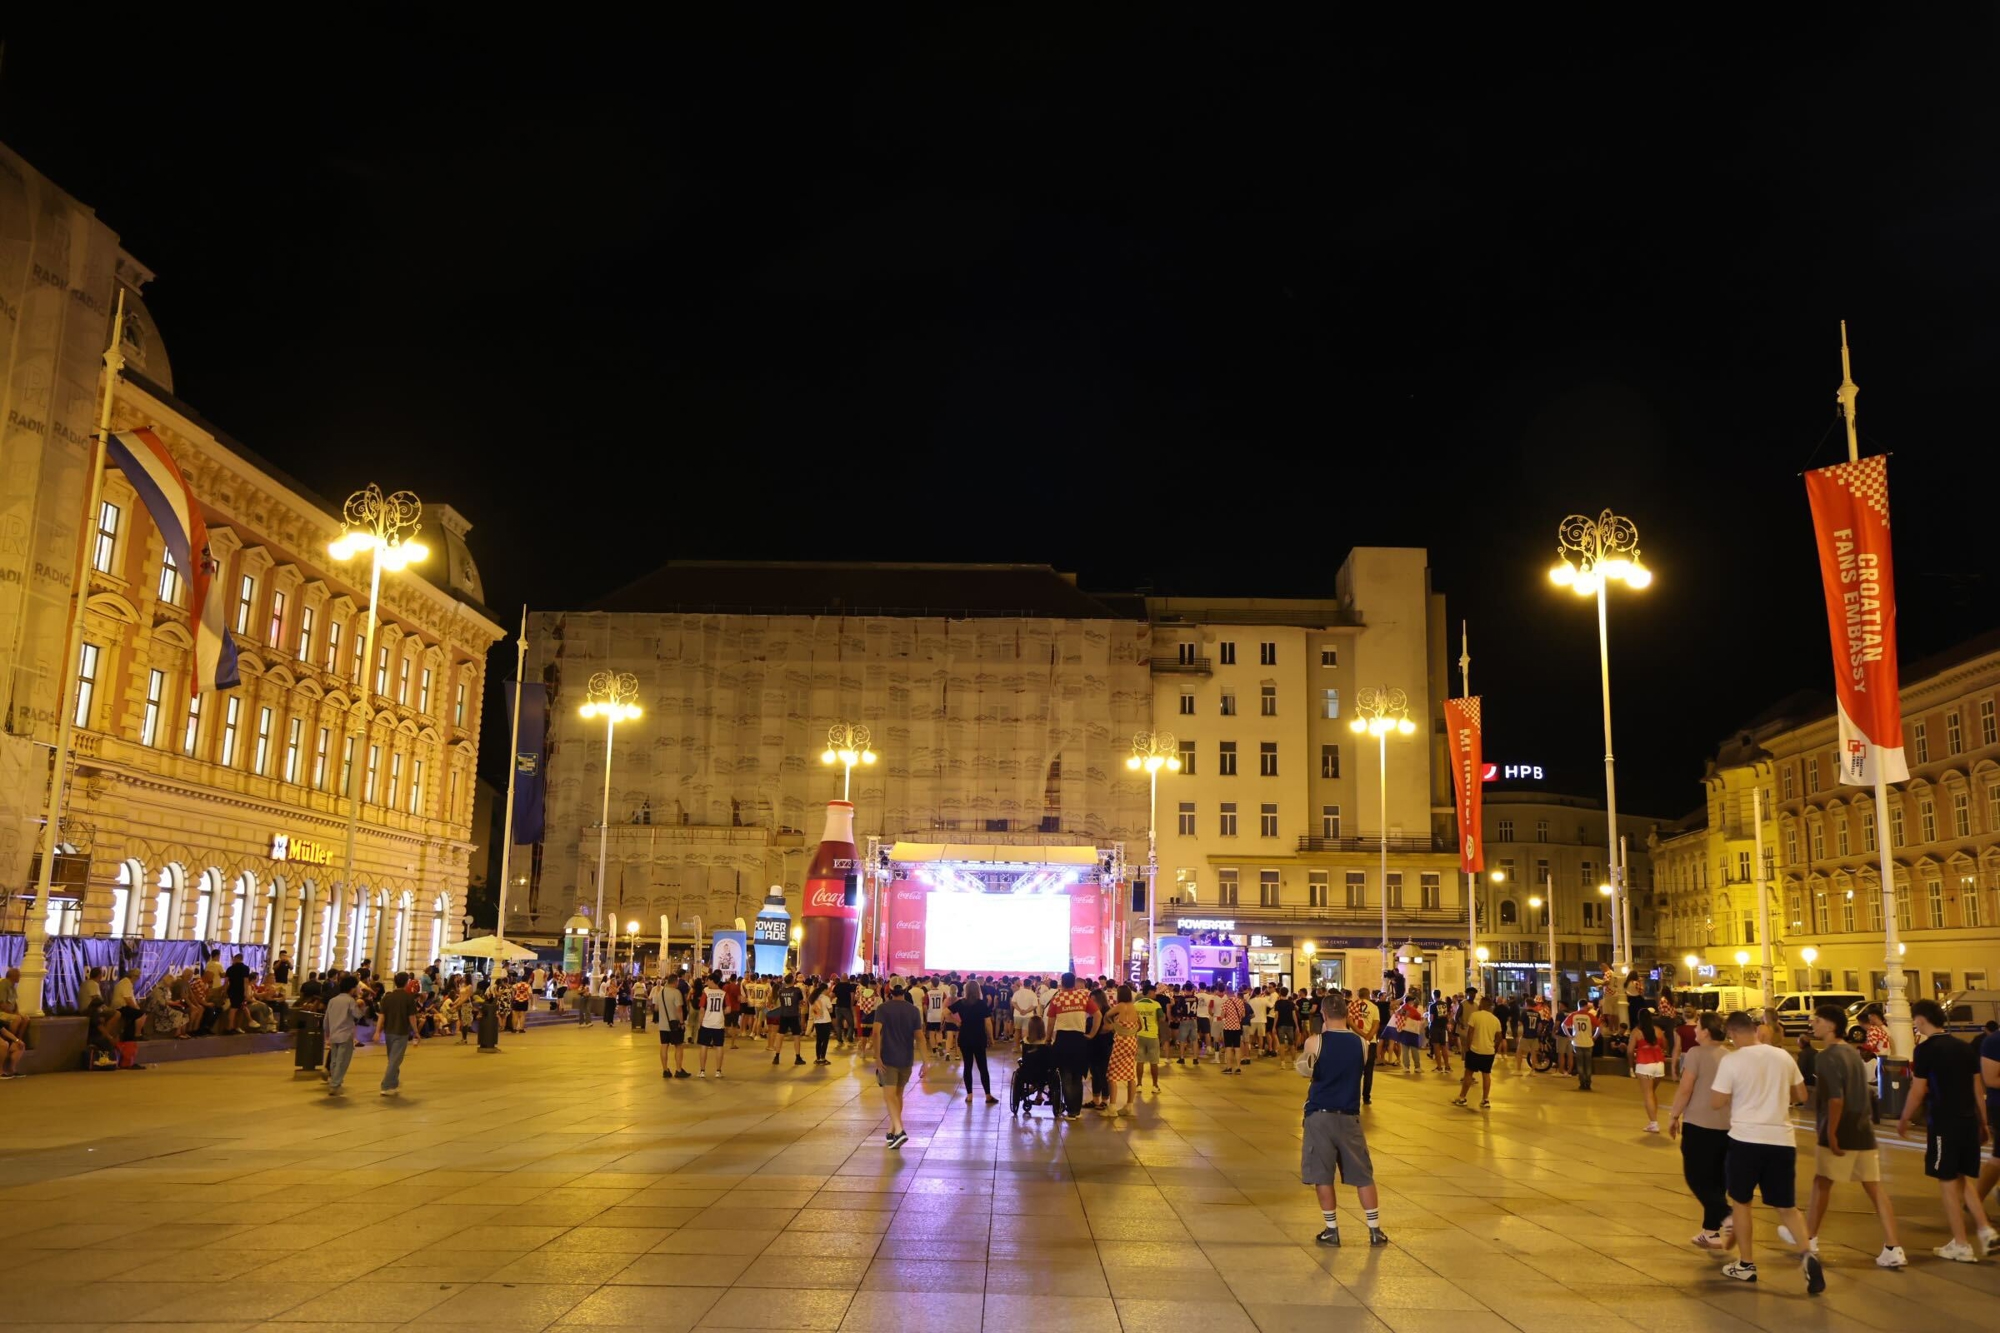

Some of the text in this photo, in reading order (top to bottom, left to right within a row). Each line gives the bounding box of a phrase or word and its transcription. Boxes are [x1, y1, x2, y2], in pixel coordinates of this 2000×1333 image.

[1833, 528, 1867, 693] FANS EMBASSY
[1858, 553, 1882, 662] CROATIAN
[1505, 765, 1543, 780] HPB
[288, 838, 334, 866] Müller
[812, 887, 846, 908] Coca-C
[1177, 918, 1236, 931] POWERADE
[765, 930, 787, 941] ADE
[709, 997, 721, 1012] 10
[932, 997, 941, 1009] 10
[1185, 1001, 1197, 1014] 14
[1577, 1022, 1587, 1032] 10
